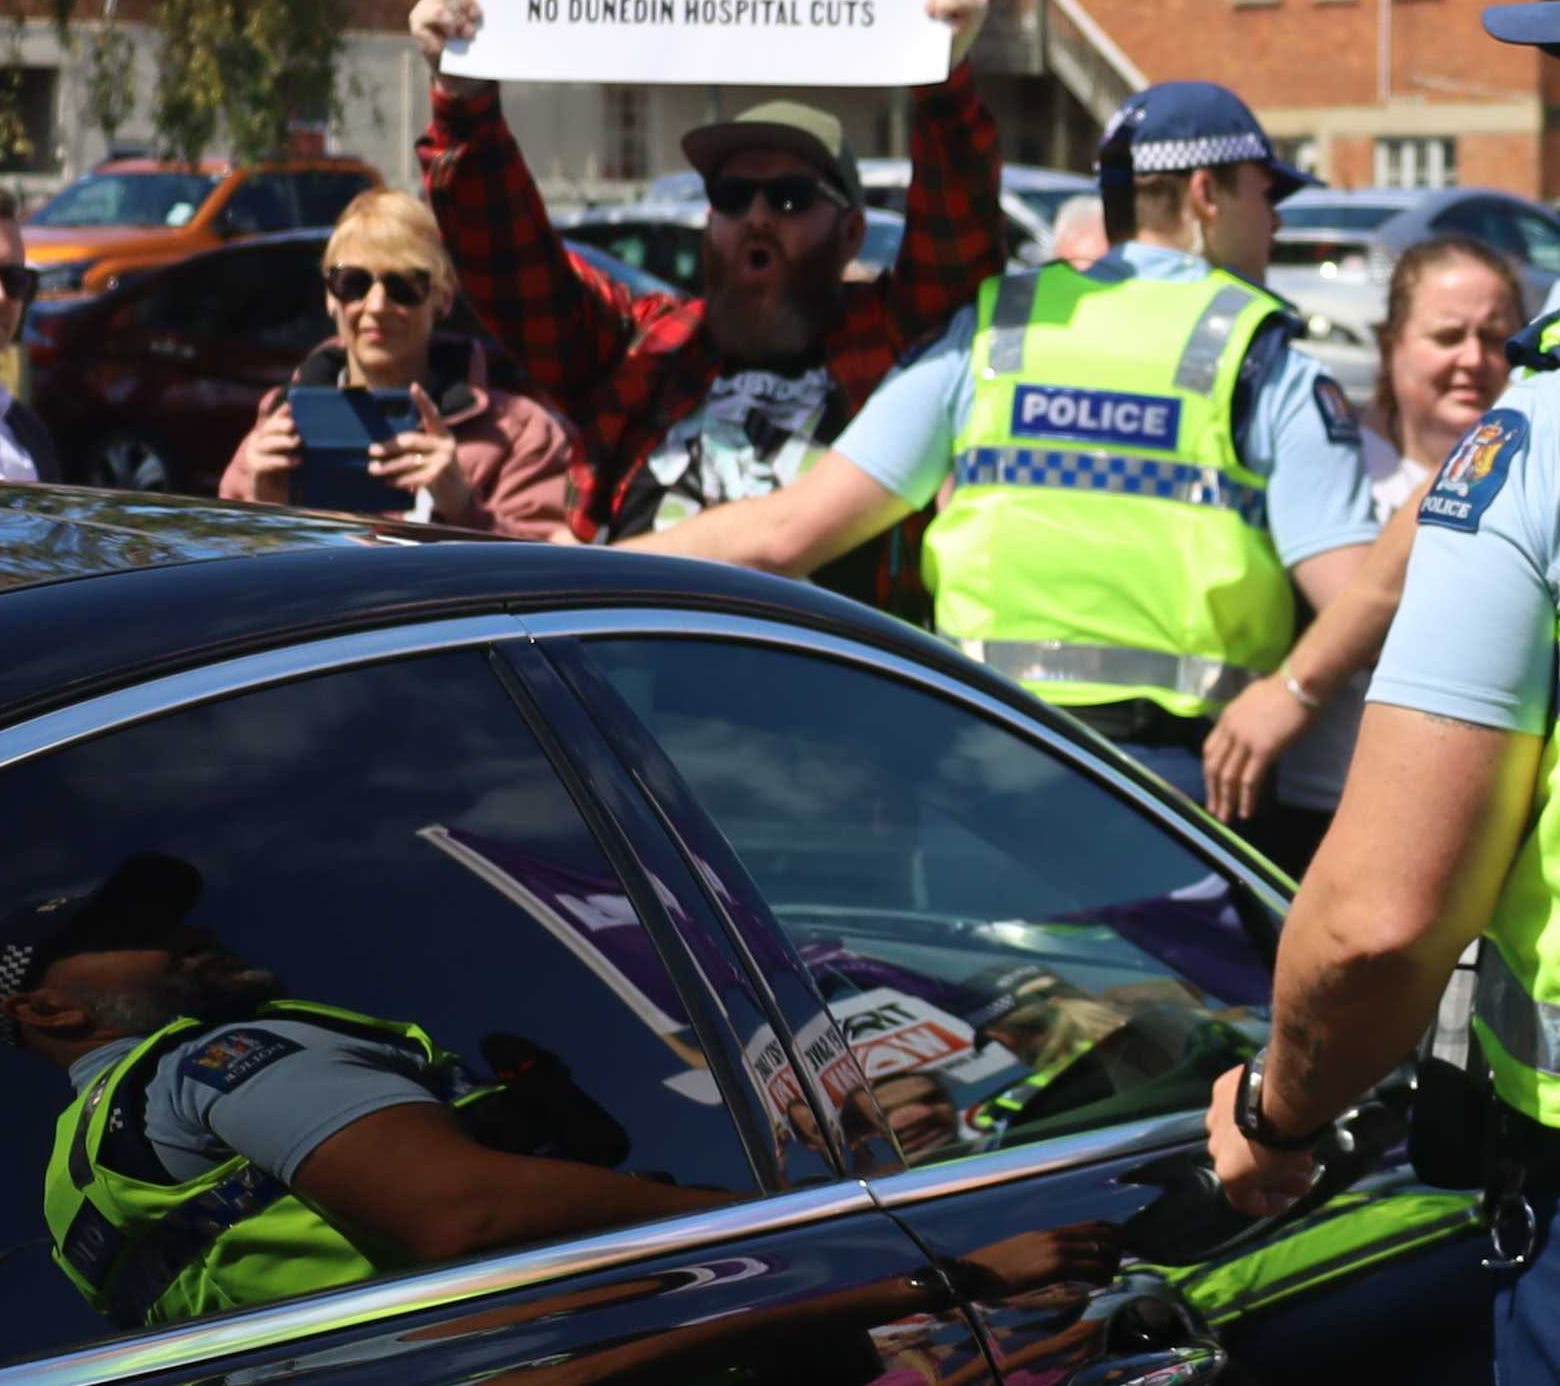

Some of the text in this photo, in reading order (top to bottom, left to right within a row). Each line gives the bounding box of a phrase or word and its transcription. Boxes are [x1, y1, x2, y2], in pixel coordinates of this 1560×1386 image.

[809, 0, 876, 28] CUTS
[1020, 391, 1169, 436] POLICE
[1420, 495, 1473, 519] POLICE
